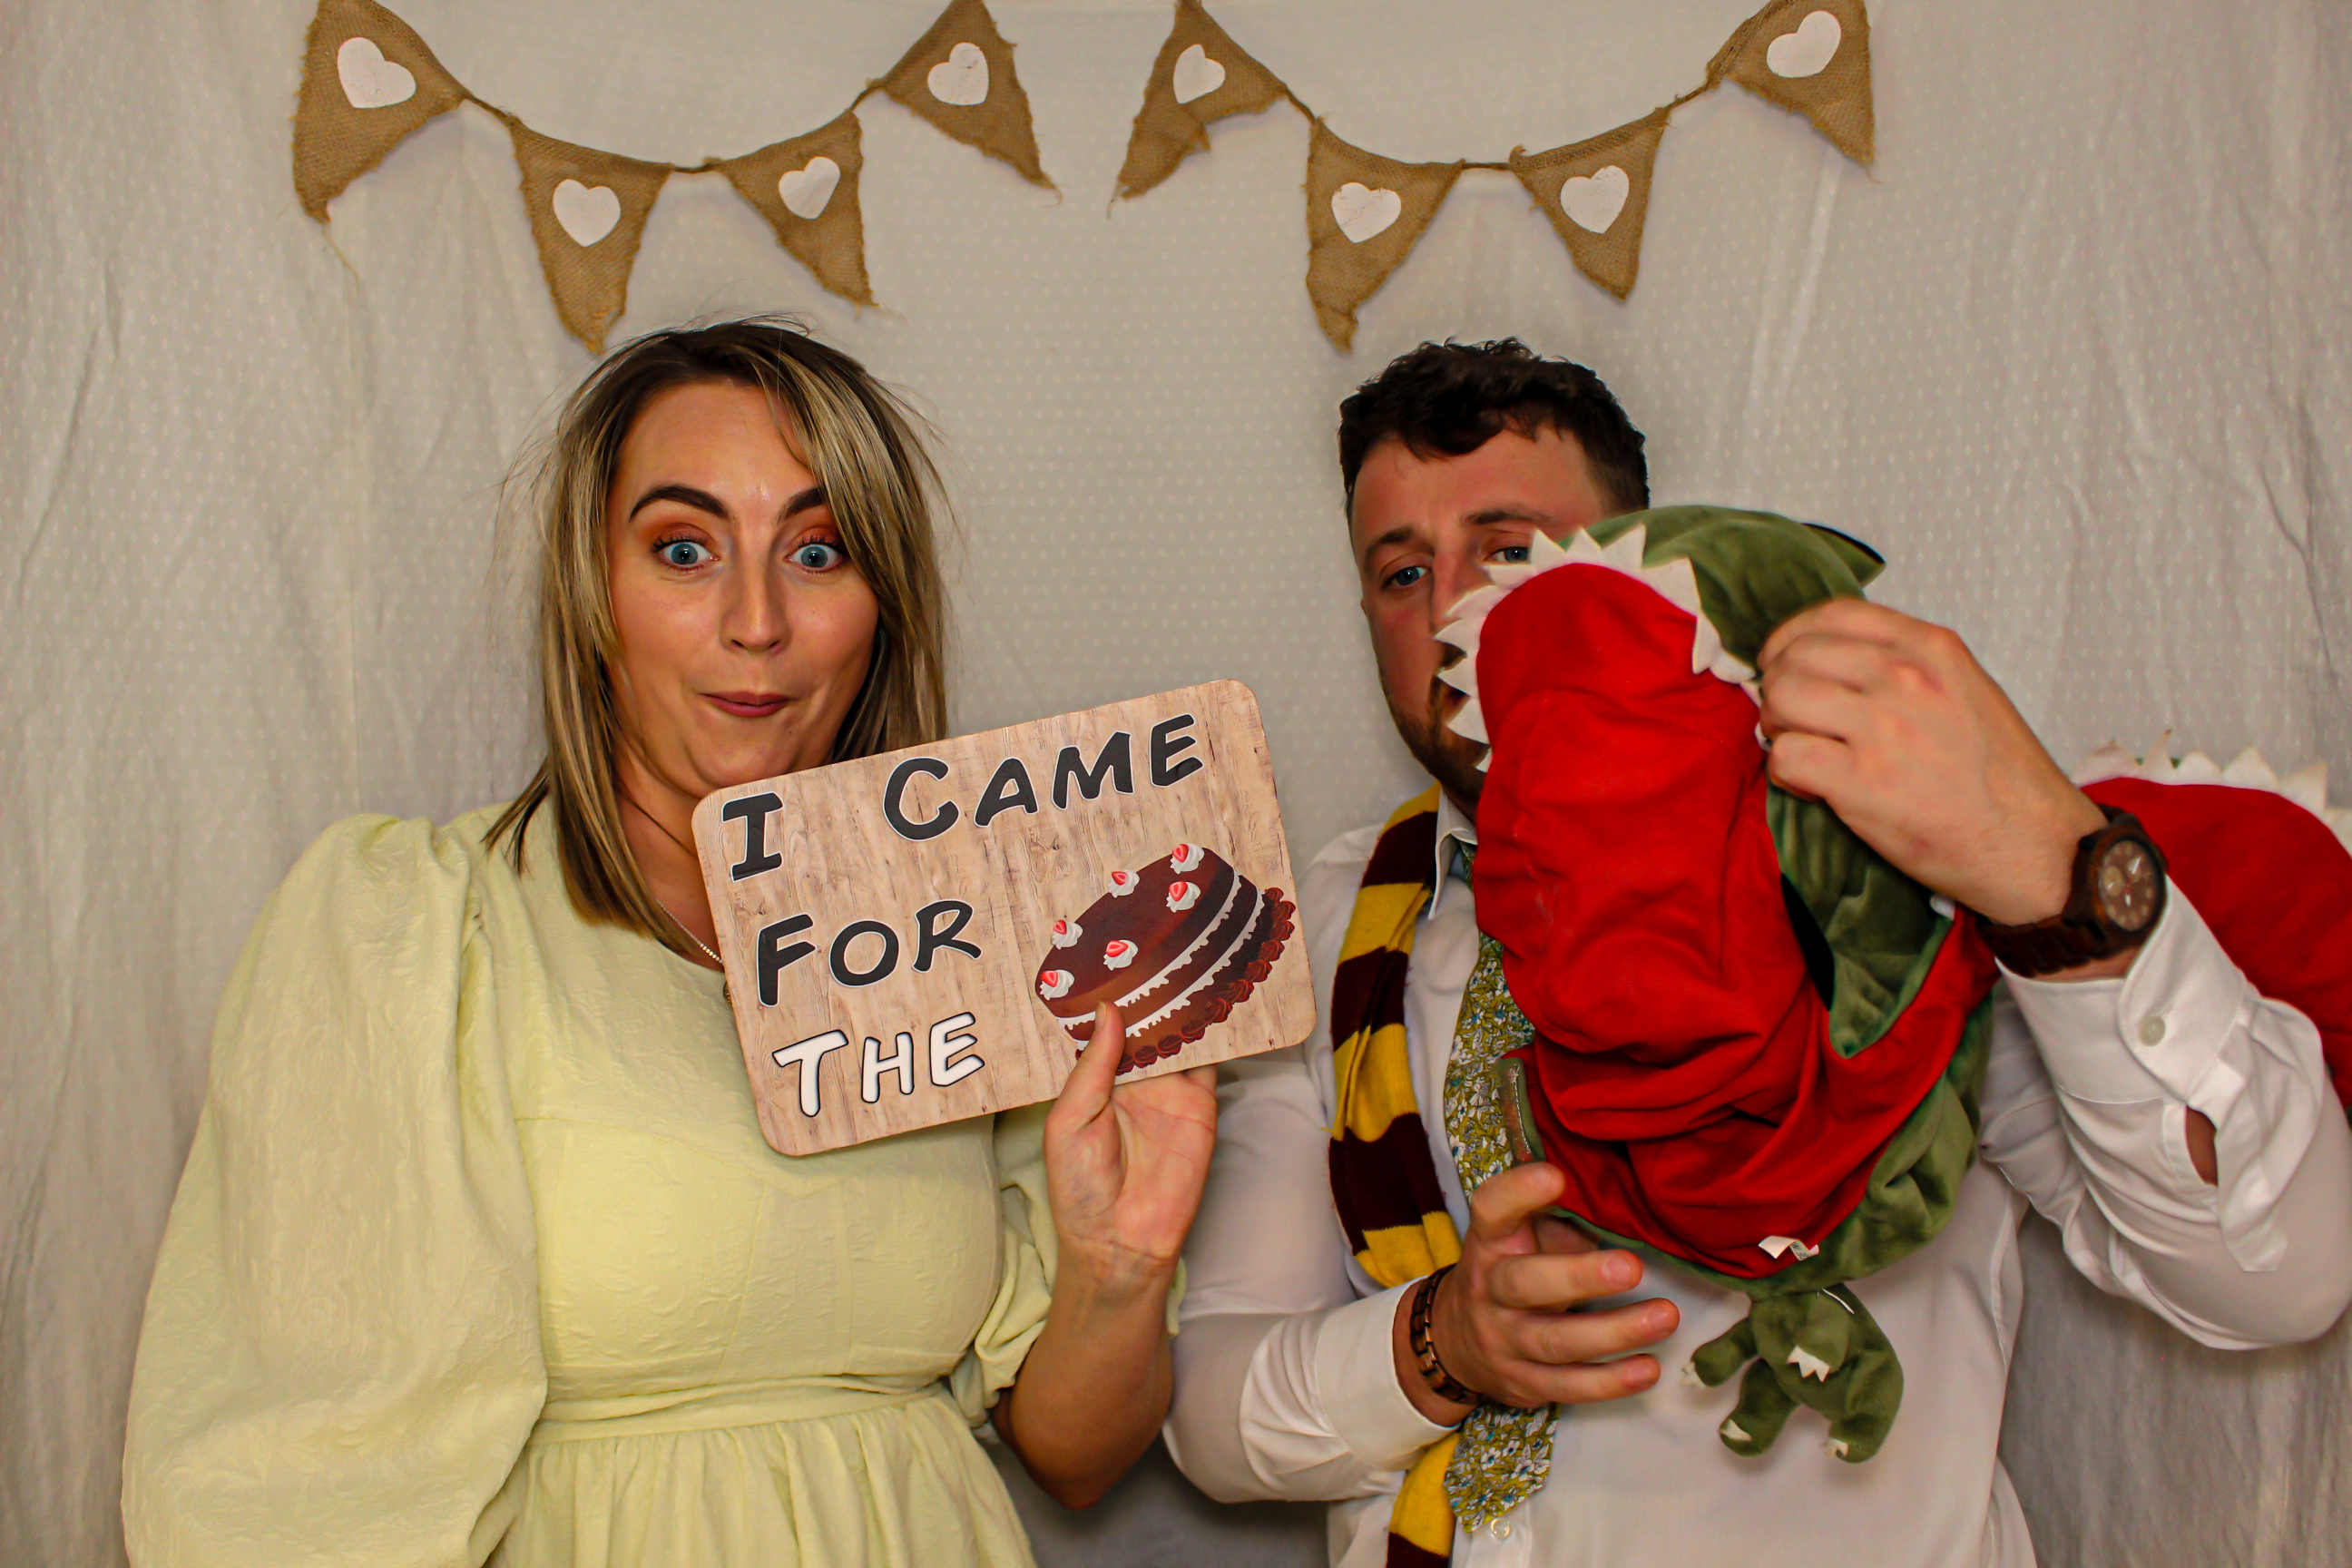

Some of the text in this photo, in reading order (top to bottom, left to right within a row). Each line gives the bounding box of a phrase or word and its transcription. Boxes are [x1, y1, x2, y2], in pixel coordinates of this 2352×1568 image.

[722, 714, 1204, 881] I CAME
[757, 900, 982, 1006] FOR
[773, 1012, 985, 1118] THE
